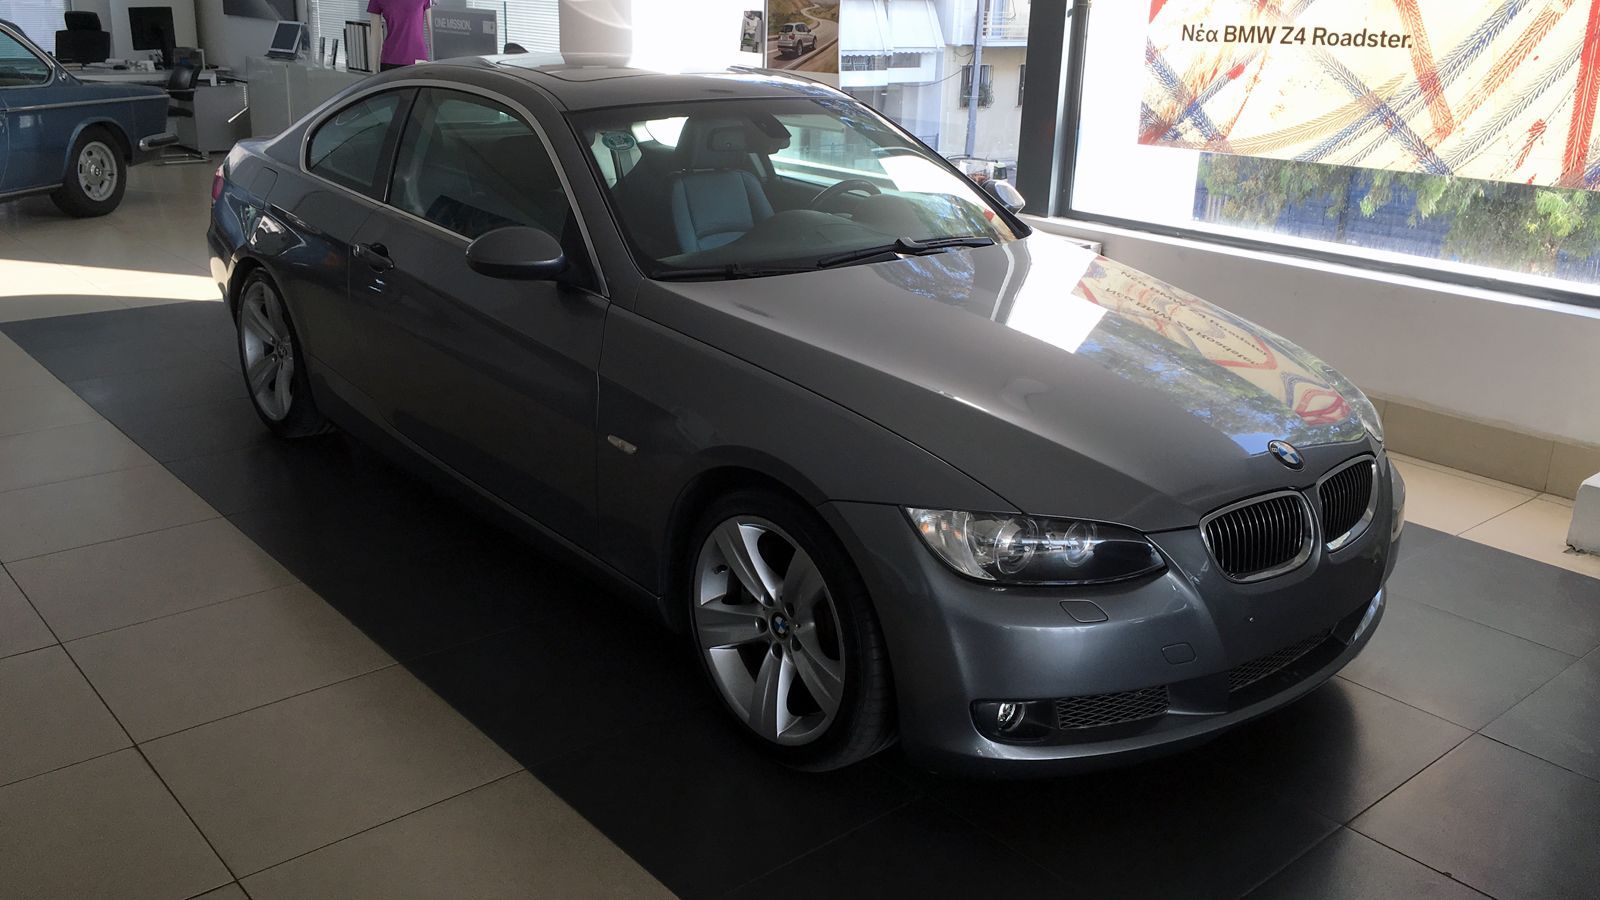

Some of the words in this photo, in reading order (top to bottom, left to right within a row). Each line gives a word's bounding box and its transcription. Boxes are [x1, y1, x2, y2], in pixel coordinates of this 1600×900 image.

[1182, 23, 1218, 43] Νέα
[1223, 25, 1277, 44] BMW
[1280, 26, 1306, 45] Z4
[1312, 27, 1412, 48] Roadster.
